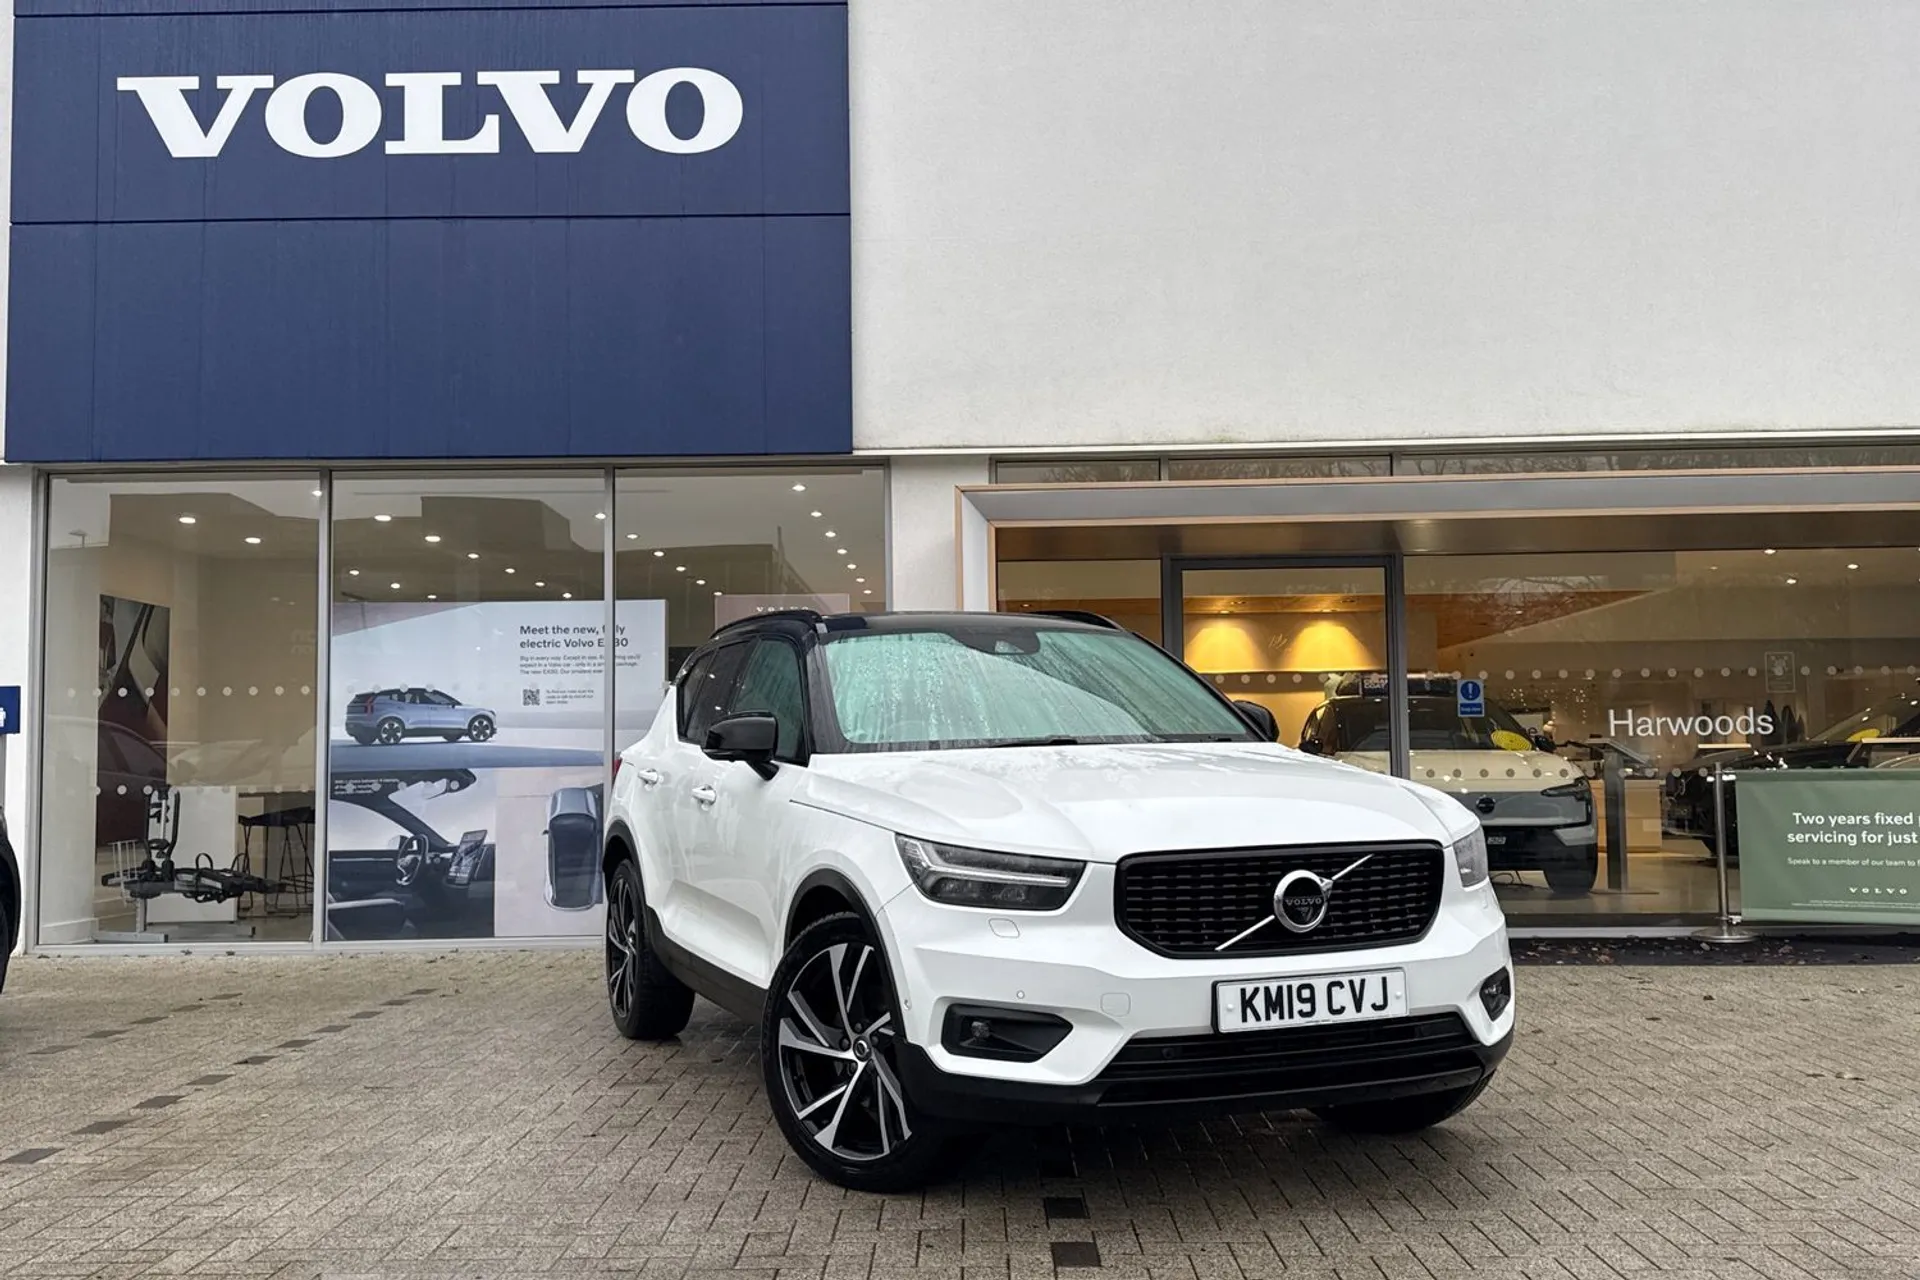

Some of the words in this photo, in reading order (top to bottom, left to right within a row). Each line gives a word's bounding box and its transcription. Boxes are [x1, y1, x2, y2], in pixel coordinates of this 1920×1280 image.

[116, 67, 744, 159] VOLVO
[519, 625, 549, 635] Meet
[551, 625, 570, 635] the
[573, 626, 600, 636] new,
[519, 639, 561, 649] electric
[564, 638, 594, 648] Volvo
[597, 637, 629, 648] E30
[1607, 706, 1775, 737] Harwoods
[1792, 812, 1825, 825] Two
[1828, 814, 1871, 828] years
[1874, 812, 1914, 825] fixed
[1787, 830, 1858, 846] servicing
[1861, 830, 1884, 844] for
[1887, 831, 1919, 847] just
[1787, 857, 1811, 866] Speak
[1812, 858, 1820, 866] to
[1828, 858, 1860, 866] member
[1861, 858, 1870, 866] of
[1886, 859, 1906, 867] team
[1907, 859, 1916, 867] to
[1848, 886, 1908, 895] VOLVO
[1284, 896, 1322, 906] VOLVO
[1239, 982, 1317, 1024] KM19
[1326, 976, 1389, 1016] CVJ
